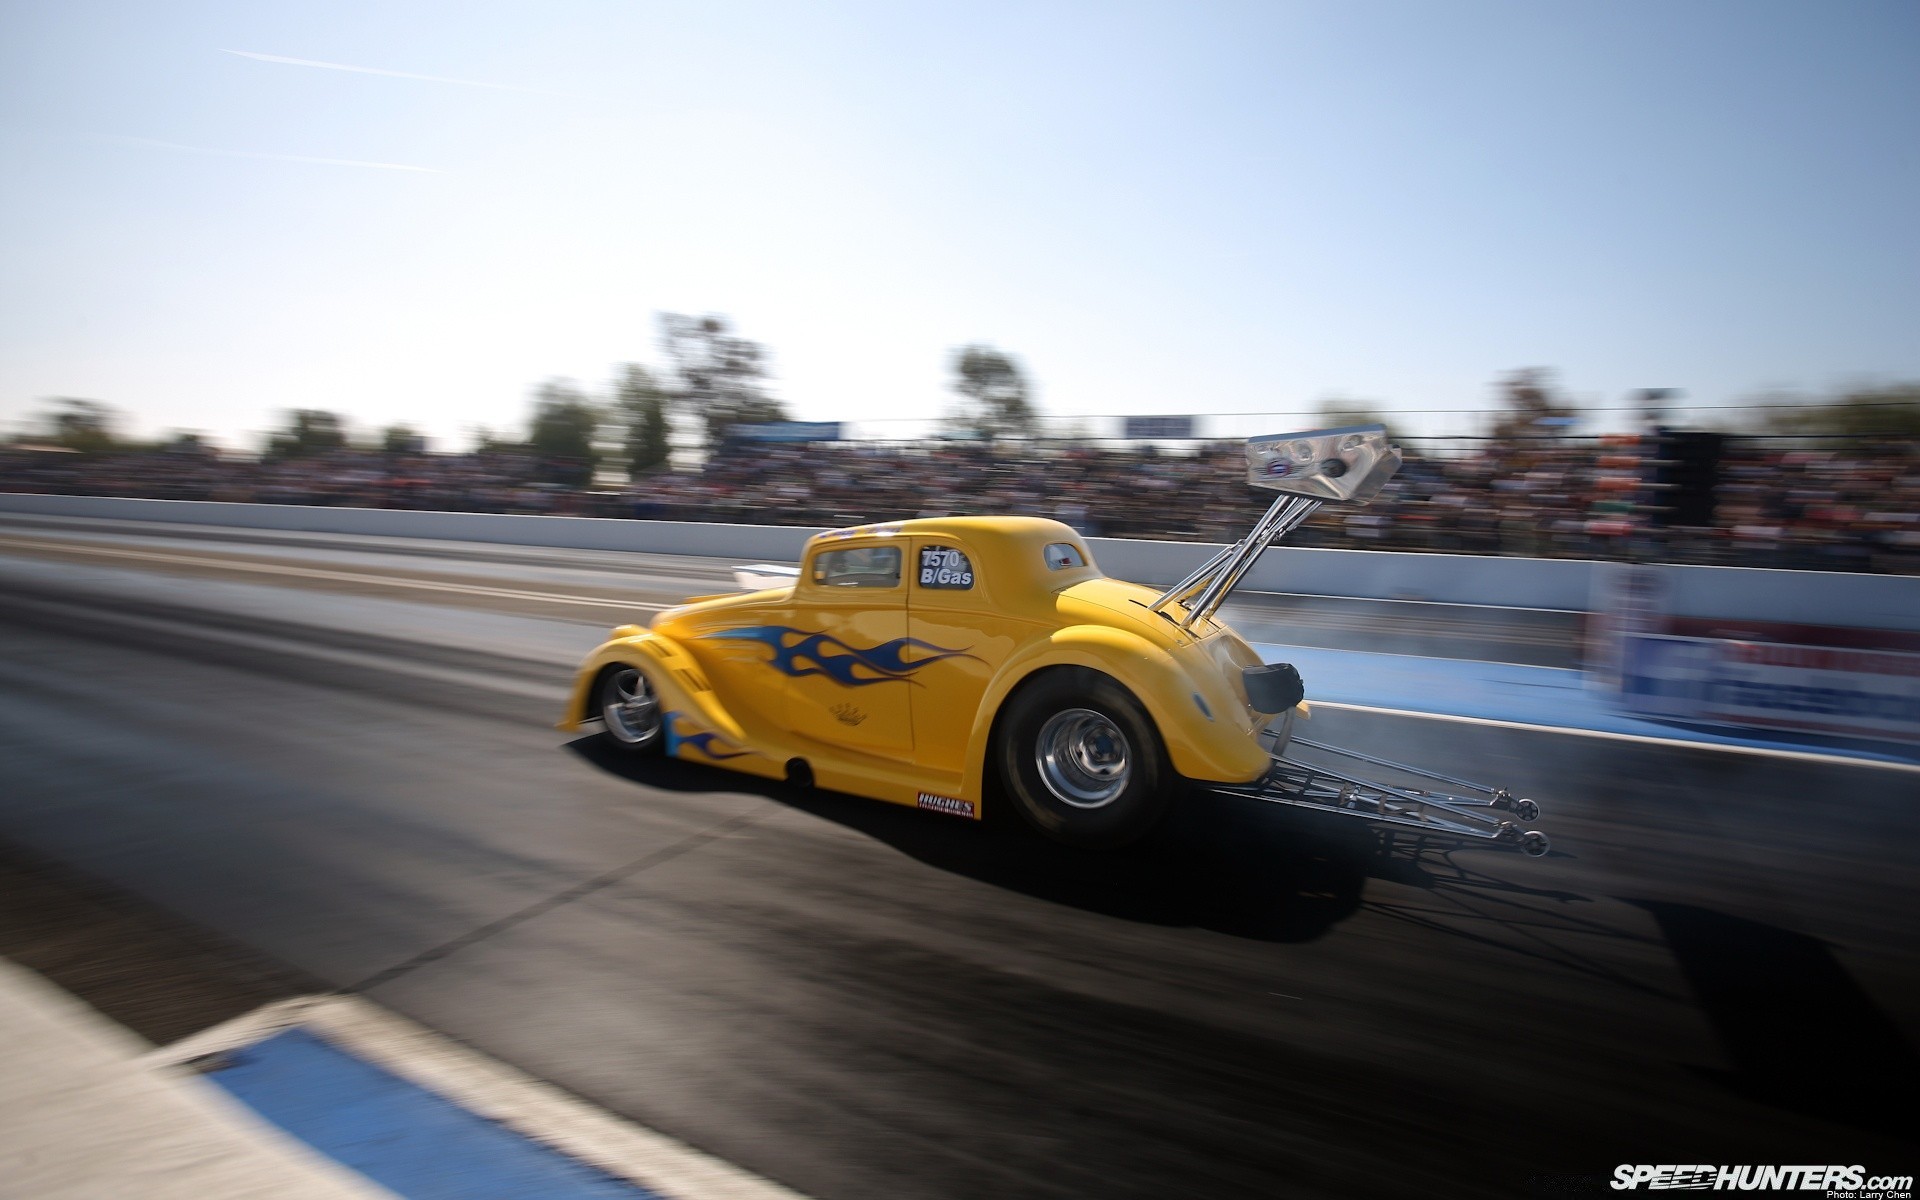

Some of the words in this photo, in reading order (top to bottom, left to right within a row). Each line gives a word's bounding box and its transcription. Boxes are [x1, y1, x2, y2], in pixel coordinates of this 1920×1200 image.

[922, 550, 959, 567] 7570
[920, 568, 972, 585] B/Gas
[919, 793, 972, 811] HUGHES
